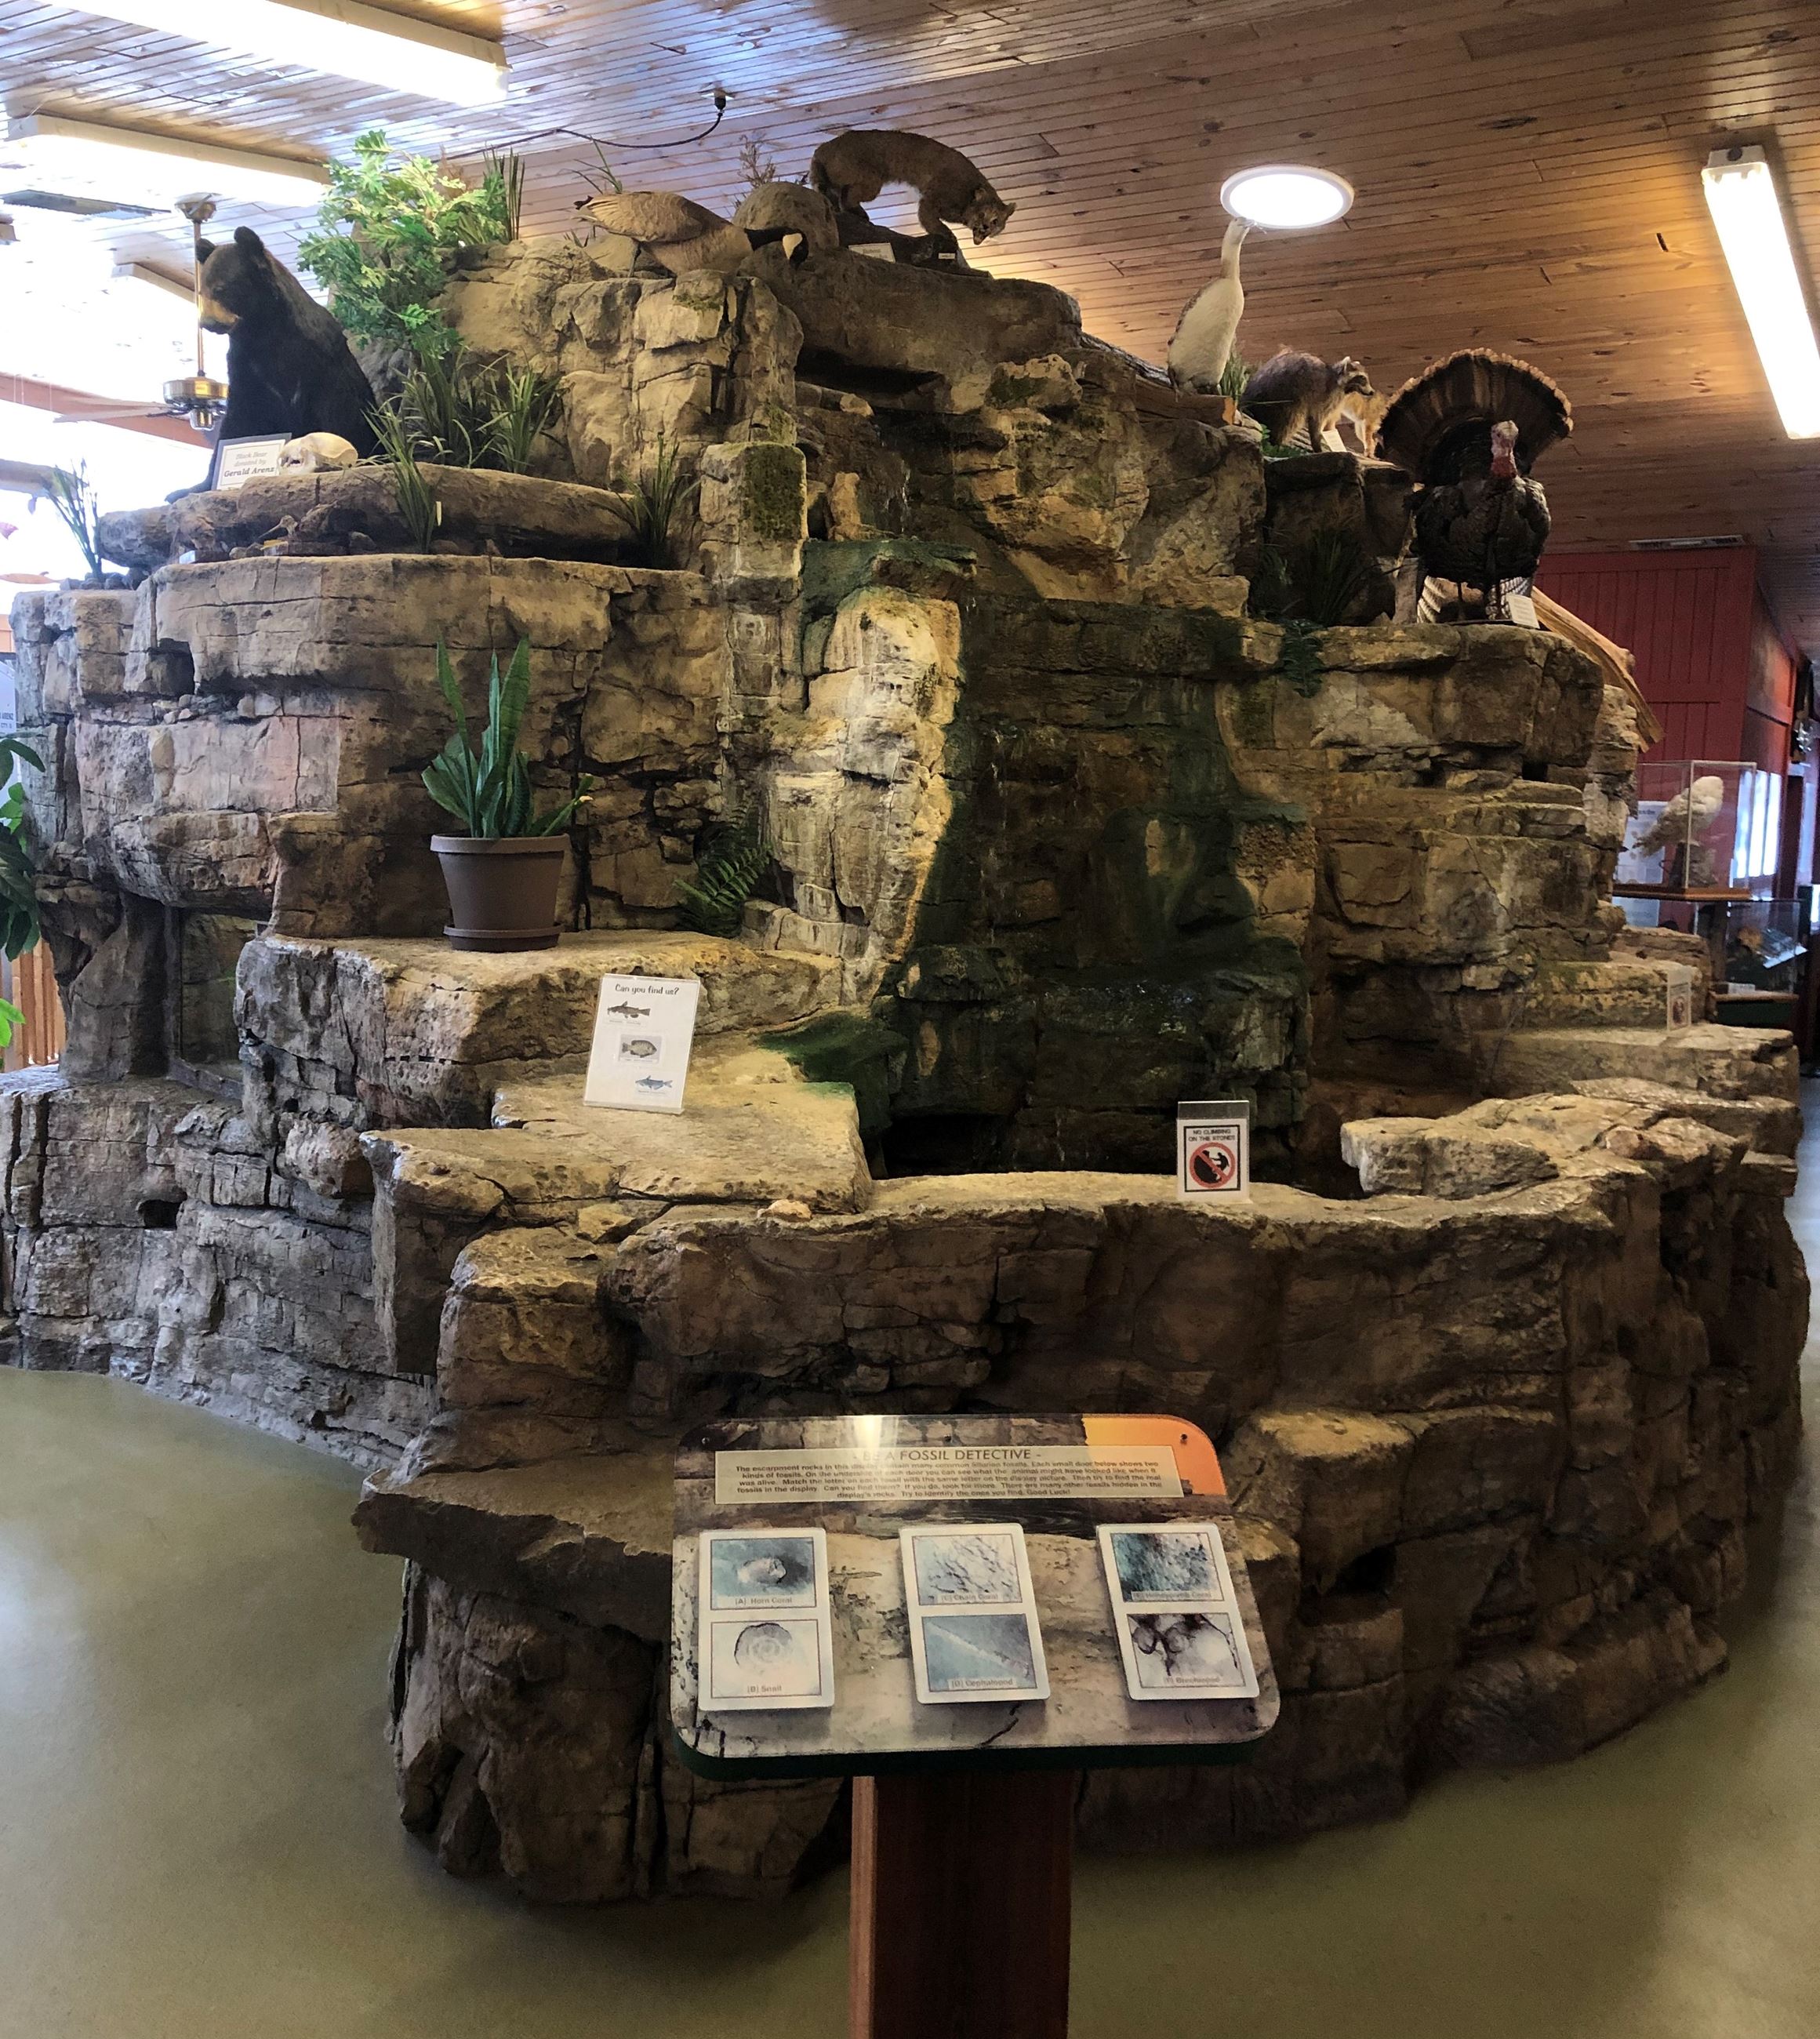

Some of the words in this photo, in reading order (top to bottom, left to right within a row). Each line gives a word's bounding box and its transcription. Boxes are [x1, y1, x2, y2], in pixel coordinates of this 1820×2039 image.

[224, 467, 250, 478] Gerald
[615, 983, 630, 992] Can
[632, 987, 645, 995] you
[648, 985, 663, 994] find
[885, 1451, 895, 1461] A
[900, 1450, 949, 1460] FOSSIL
[955, 1449, 1030, 1459] DETECTIVE
